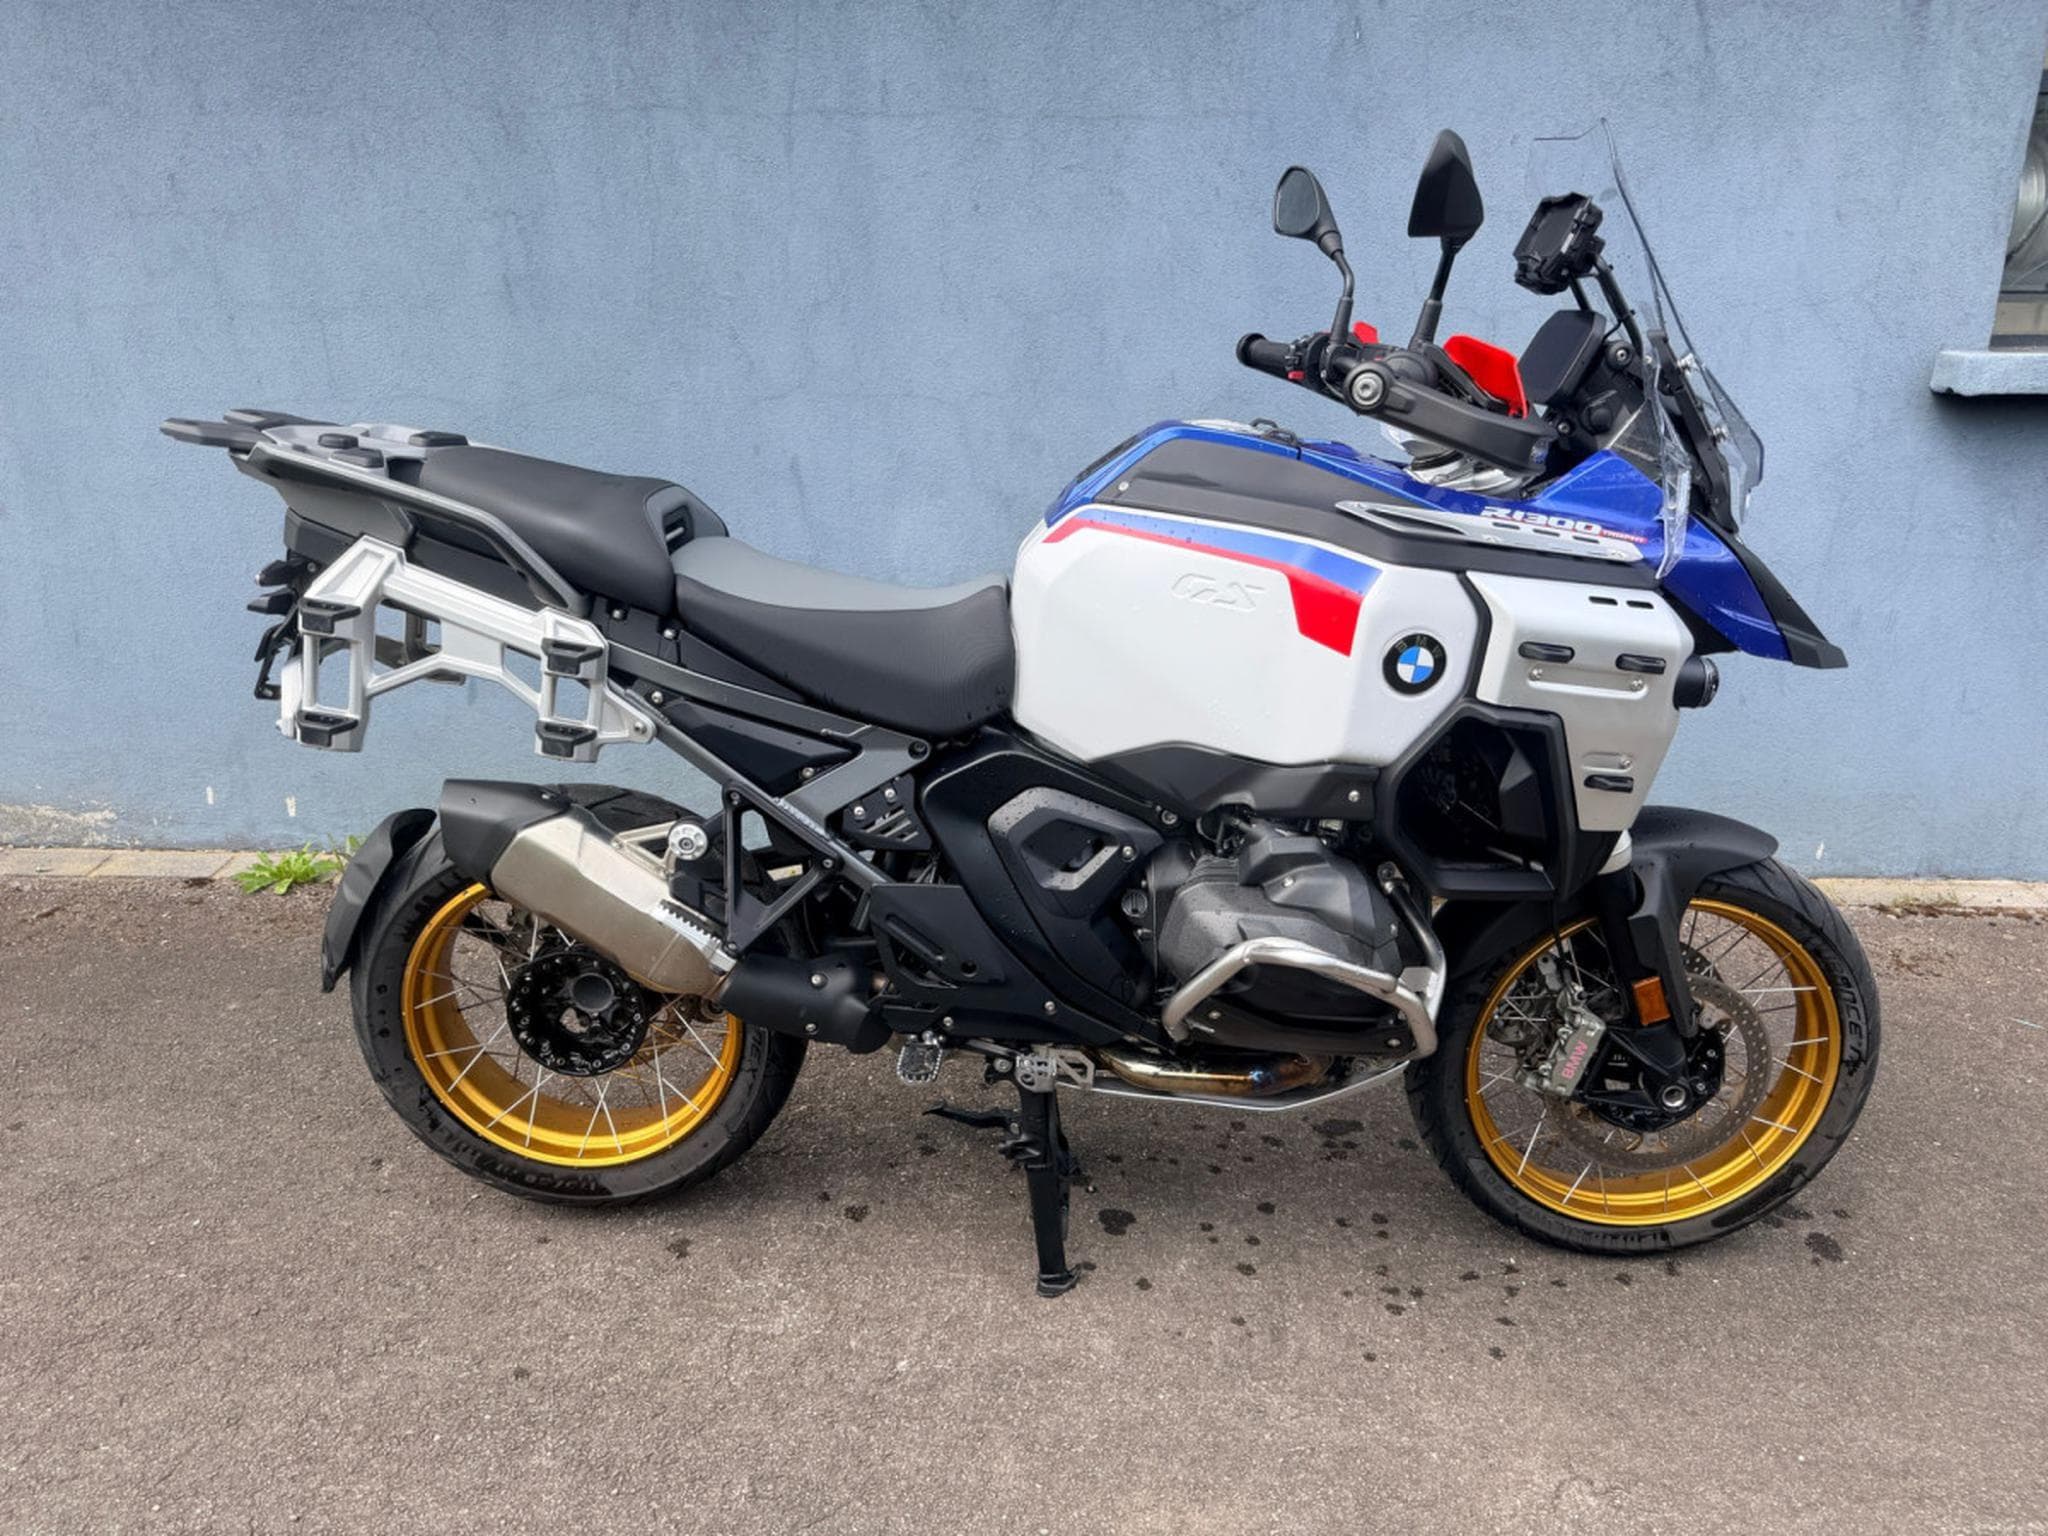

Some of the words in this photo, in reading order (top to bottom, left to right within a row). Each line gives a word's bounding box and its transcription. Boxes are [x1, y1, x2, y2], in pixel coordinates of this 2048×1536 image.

[1480, 506, 1602, 535] R1300
[1169, 570, 1269, 612] GS
[1560, 1040, 1589, 1079] BMW
